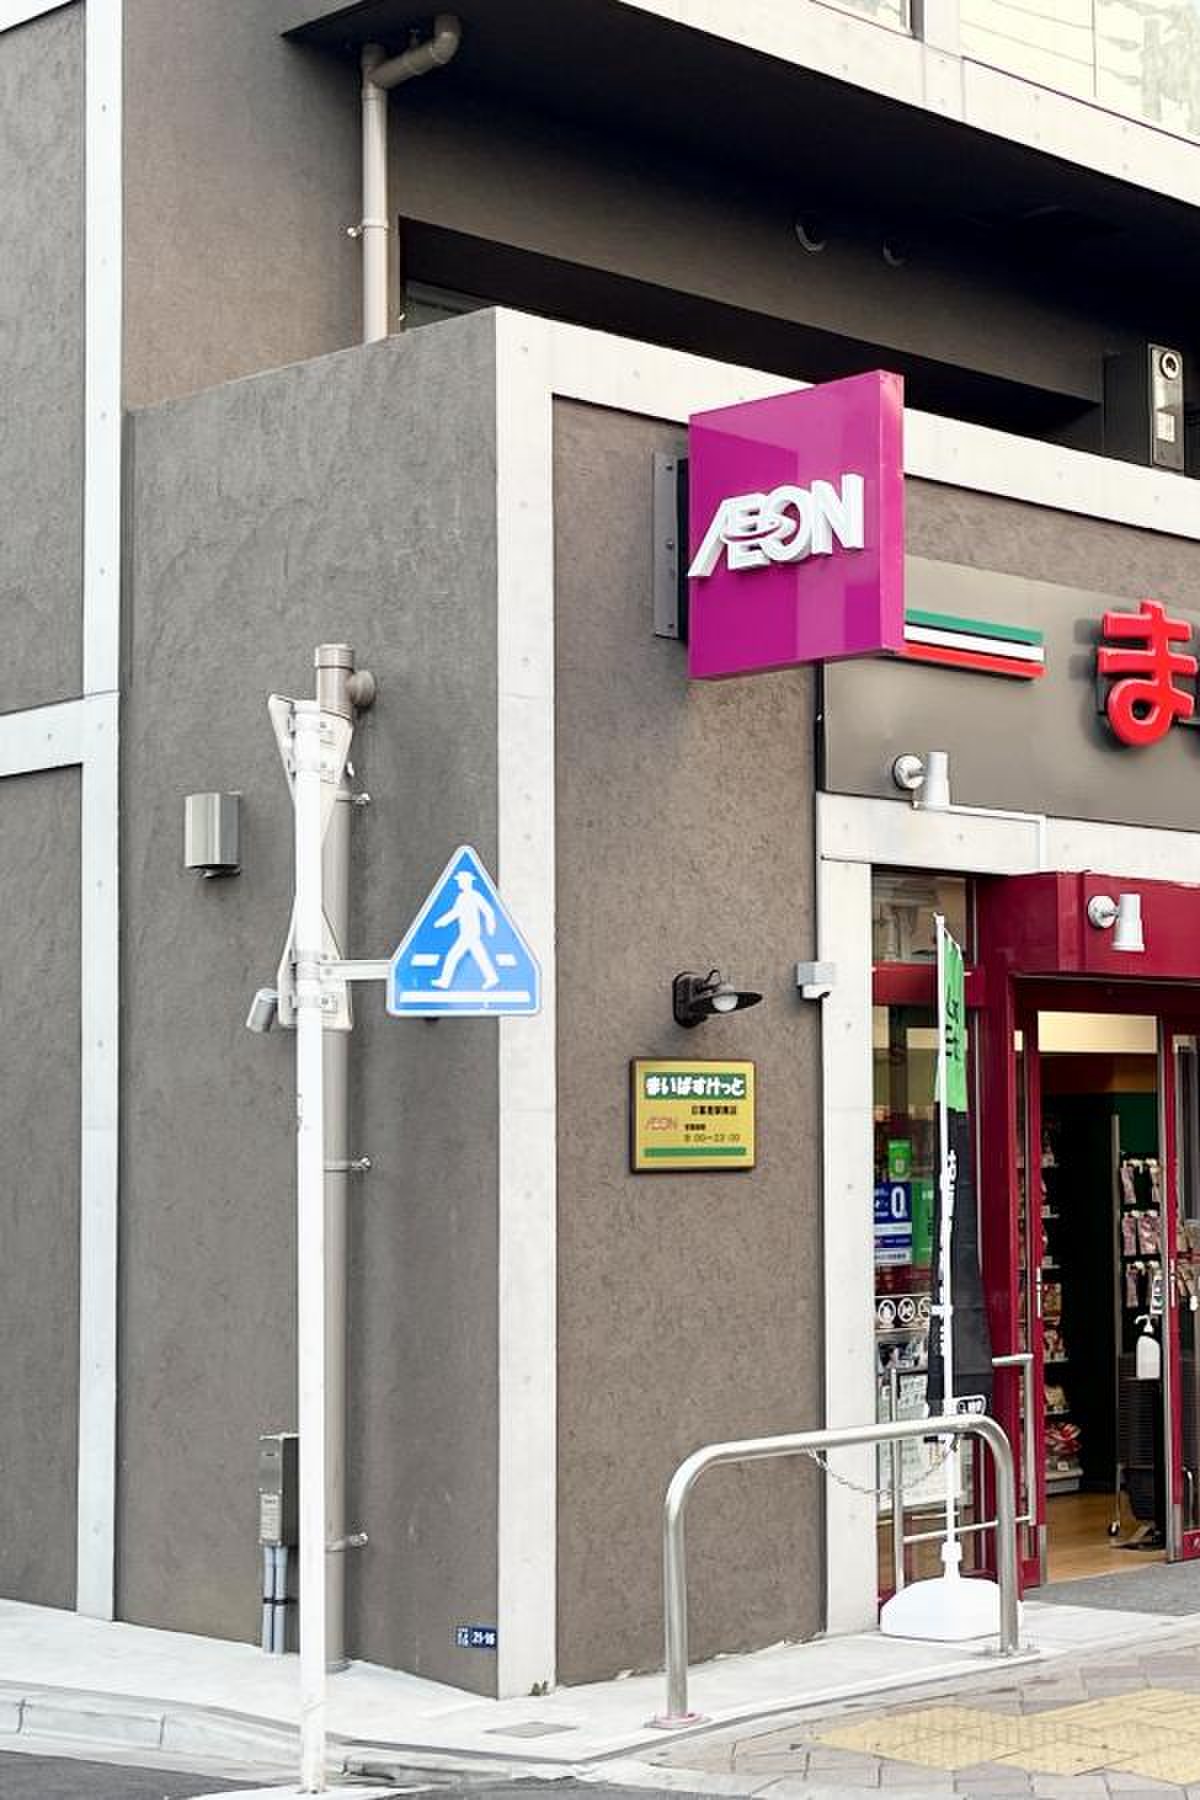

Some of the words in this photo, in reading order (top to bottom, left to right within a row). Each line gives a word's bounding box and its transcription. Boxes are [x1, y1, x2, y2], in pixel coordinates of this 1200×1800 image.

[688, 473, 865, 577] AEON
[646, 1076, 745, 1096] まいばすけっと
